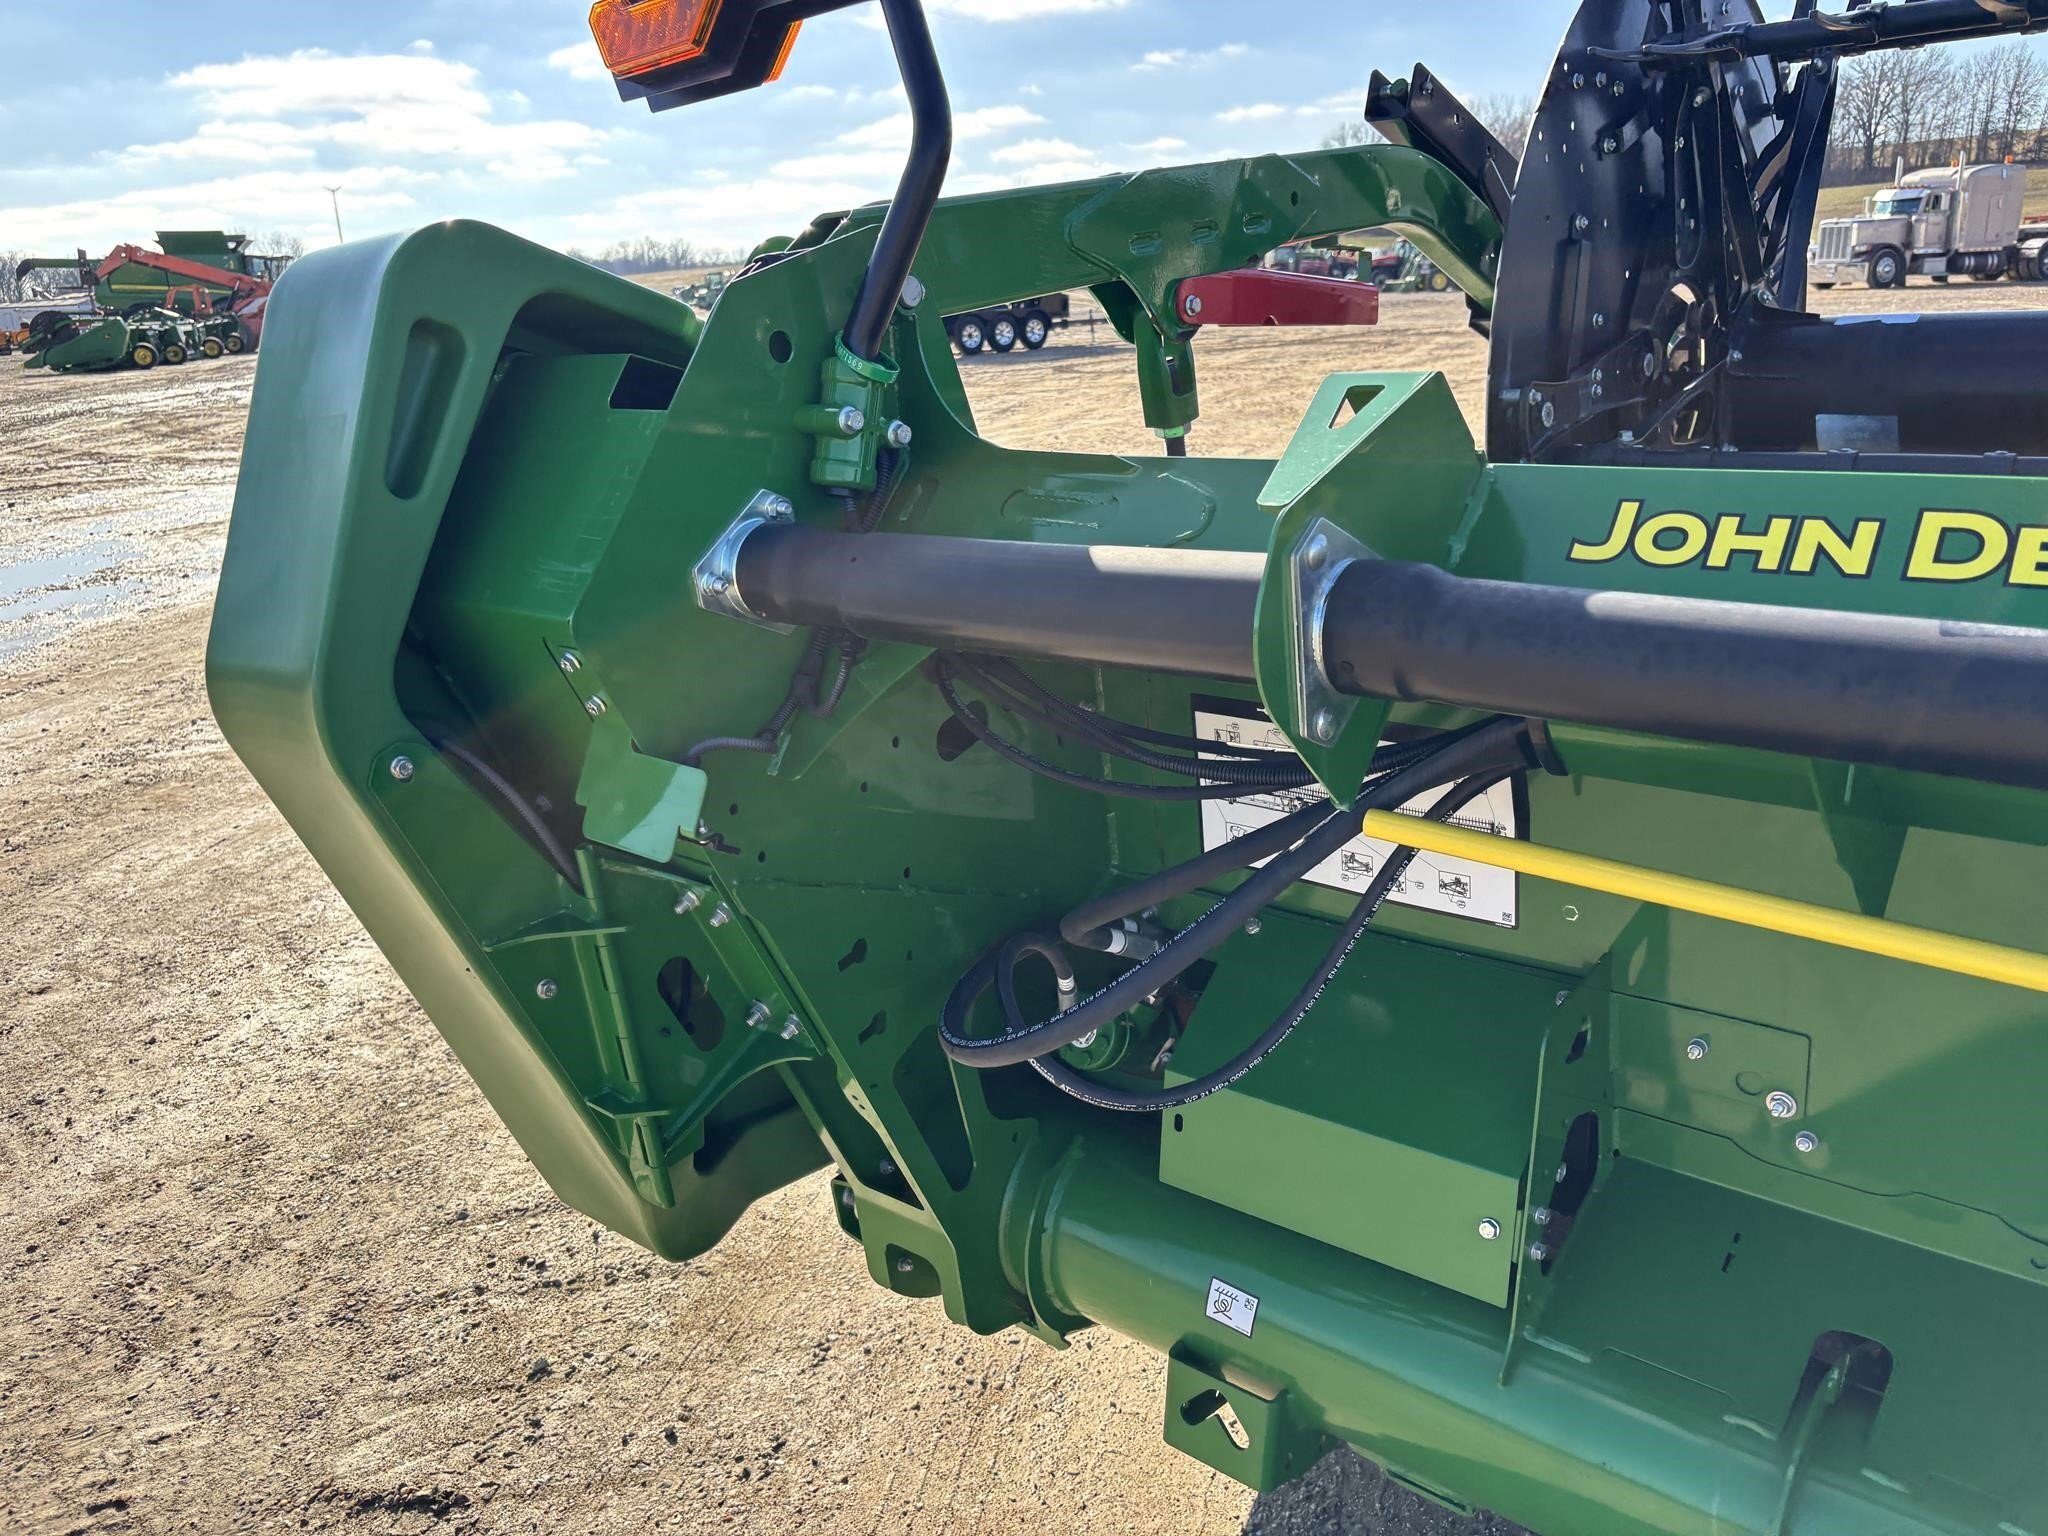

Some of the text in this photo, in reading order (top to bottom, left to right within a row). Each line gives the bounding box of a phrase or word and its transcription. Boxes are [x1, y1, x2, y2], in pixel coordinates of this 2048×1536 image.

[1567, 498, 1885, 578] JOHN
[1118, 964, 1141, 982] MSHA
[1173, 922, 1198, 941] MADE
[1206, 897, 1227, 915] ITALY
[1327, 967, 1338, 980] EN
[1371, 890, 1388, 913] MSHA
